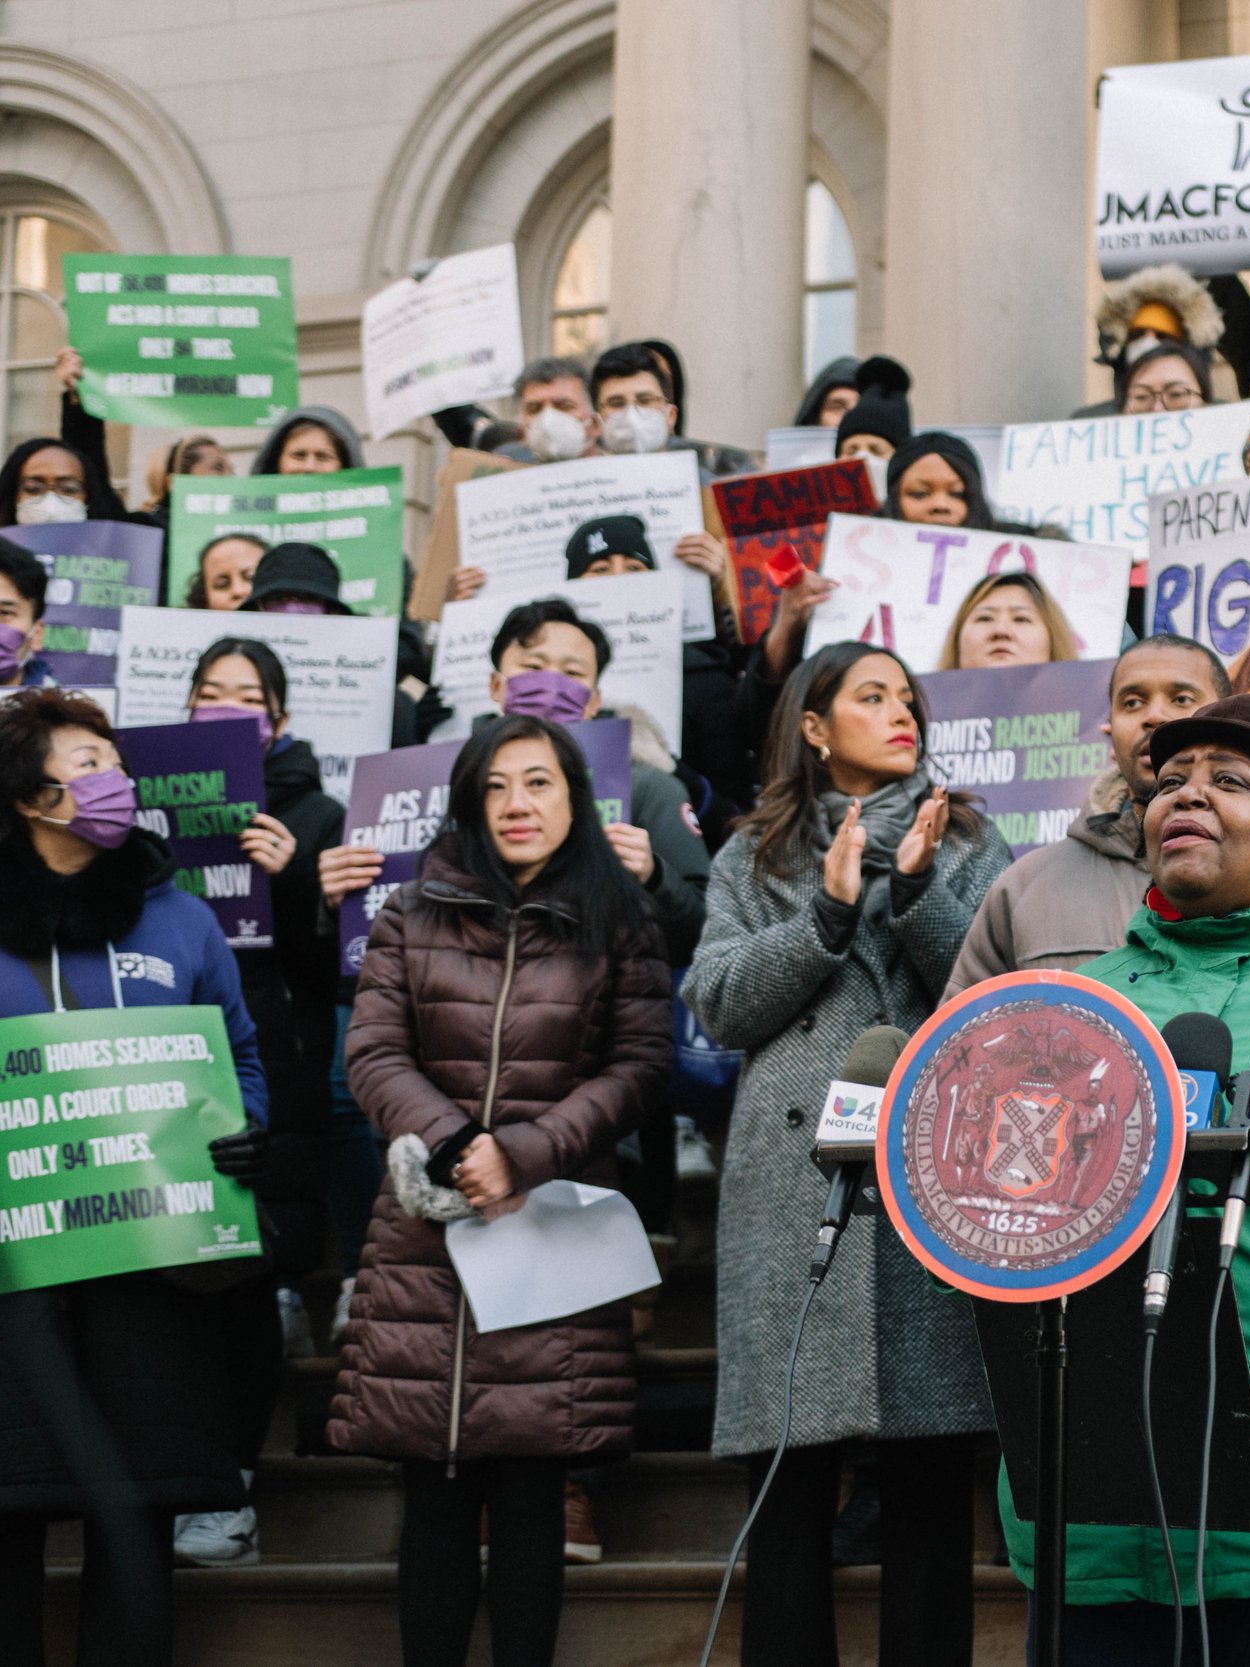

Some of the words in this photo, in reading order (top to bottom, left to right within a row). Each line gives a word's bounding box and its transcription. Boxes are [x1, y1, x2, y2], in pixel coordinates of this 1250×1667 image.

[1099, 232, 1142, 251] JUST
[1150, 225, 1230, 247] MAKING
[1238, 225, 1248, 240] A
[1004, 410, 1195, 472] FAMILIES
[722, 464, 867, 518] FAMILY
[928, 717, 993, 751] DMITS
[993, 710, 1081, 750] RACISM!
[1022, 742, 1108, 784] JUSTICE!
[137, 769, 227, 809] RACISM!
[378, 785, 421, 825] ACS
[0, 1047, 42, 1083] ,400
[44, 1038, 114, 1073] HOMES
[115, 1033, 214, 1065] SEARCHED,
[0, 1096, 40, 1132] HAD
[43, 1094, 60, 1125] A
[61, 1086, 123, 1122] COURT
[125, 1080, 189, 1113] ORDER
[825, 1118, 877, 1134] NOTICIA
[857, 1100, 877, 1122] 4
[8, 1144, 58, 1181] ONLY
[62, 1140, 88, 1171] 94
[88, 1132, 156, 1168] TIMES.
[0, 1180, 215, 1244] AMILYMIRANDANOW
